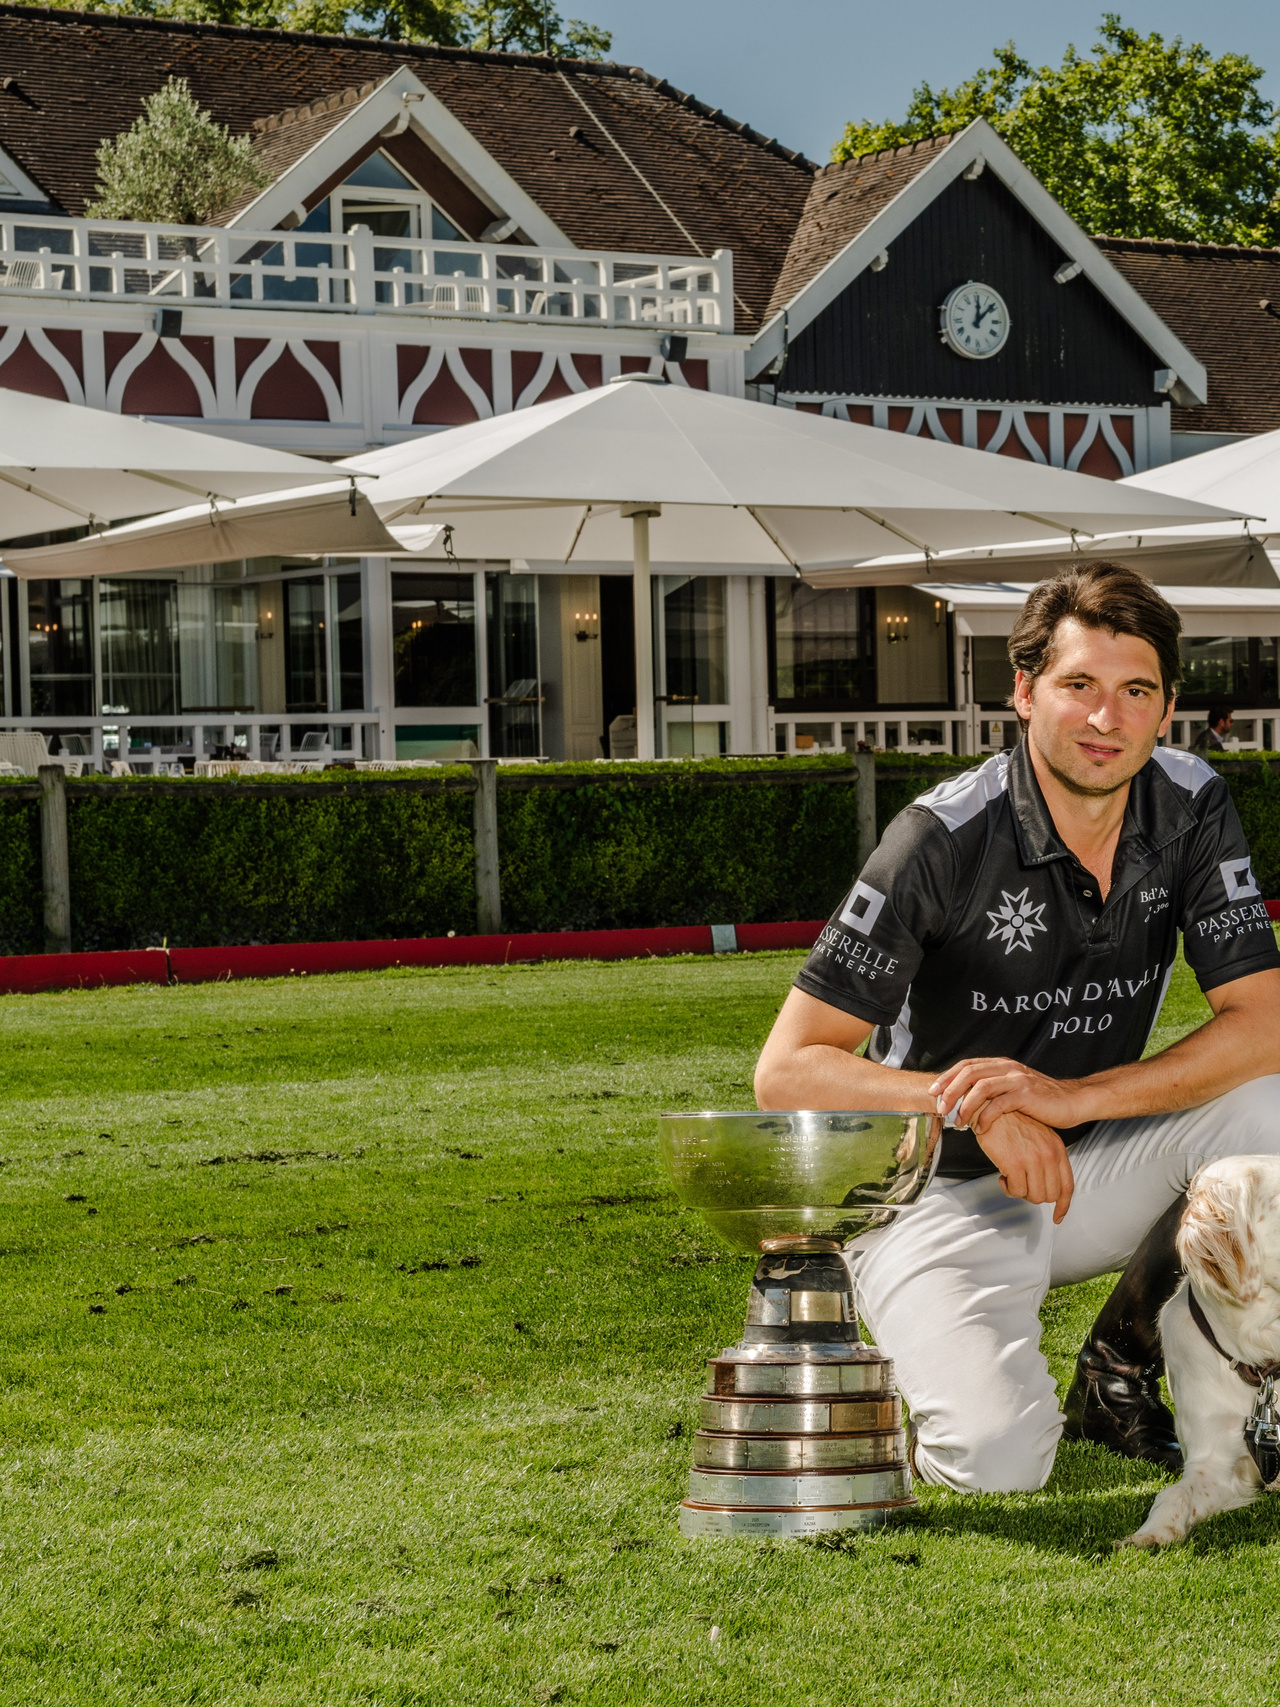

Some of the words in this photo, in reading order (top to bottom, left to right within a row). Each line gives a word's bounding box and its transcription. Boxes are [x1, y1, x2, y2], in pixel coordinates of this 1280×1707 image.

[1140, 887, 1169, 903] Bd'A
[819, 925, 899, 975] SSERELLE
[970, 986, 1073, 1014] BARON
[1049, 1013, 1113, 1040] POLO
